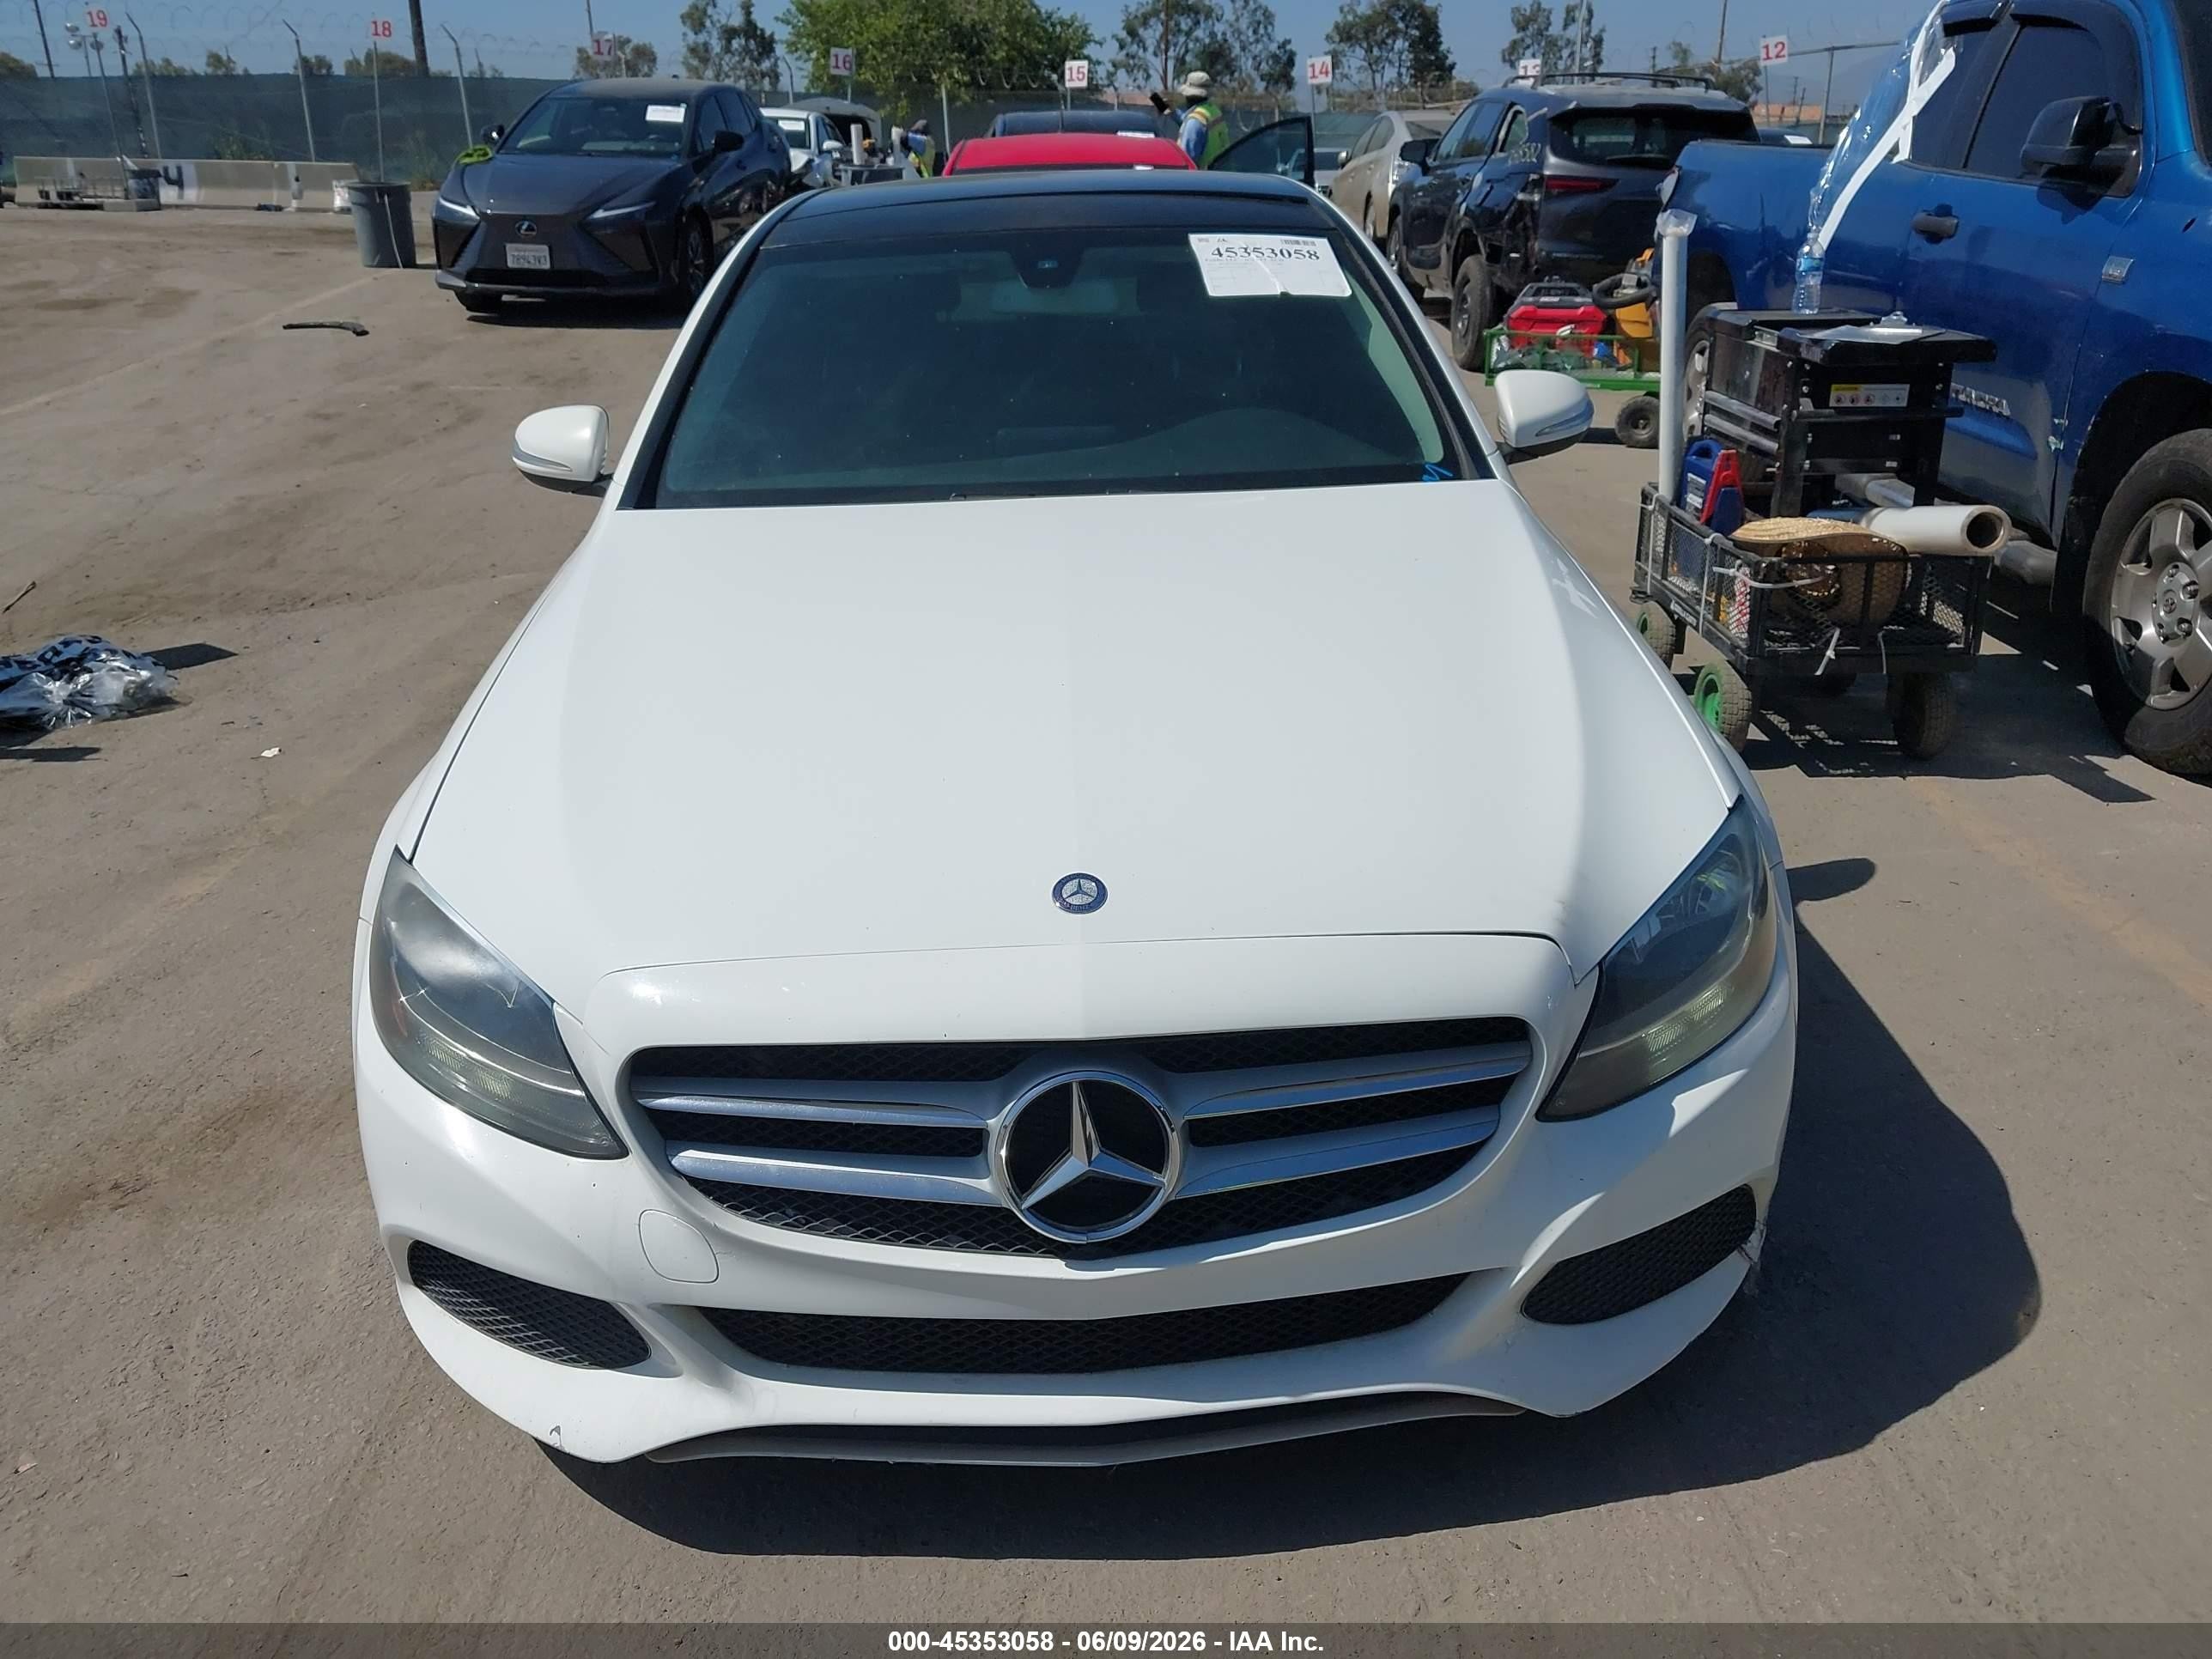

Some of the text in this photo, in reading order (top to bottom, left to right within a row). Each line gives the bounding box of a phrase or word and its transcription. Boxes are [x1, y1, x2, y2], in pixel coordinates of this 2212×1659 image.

[87, 9, 107, 27] 19
[371, 20, 392, 38] 18
[593, 38, 613, 56] 17
[1762, 41, 1786, 60] 12
[832, 53, 852, 70] 16
[1309, 61, 1330, 79] 14
[1067, 65, 1086, 82] 15
[1211, 246, 1321, 261] 45353058
